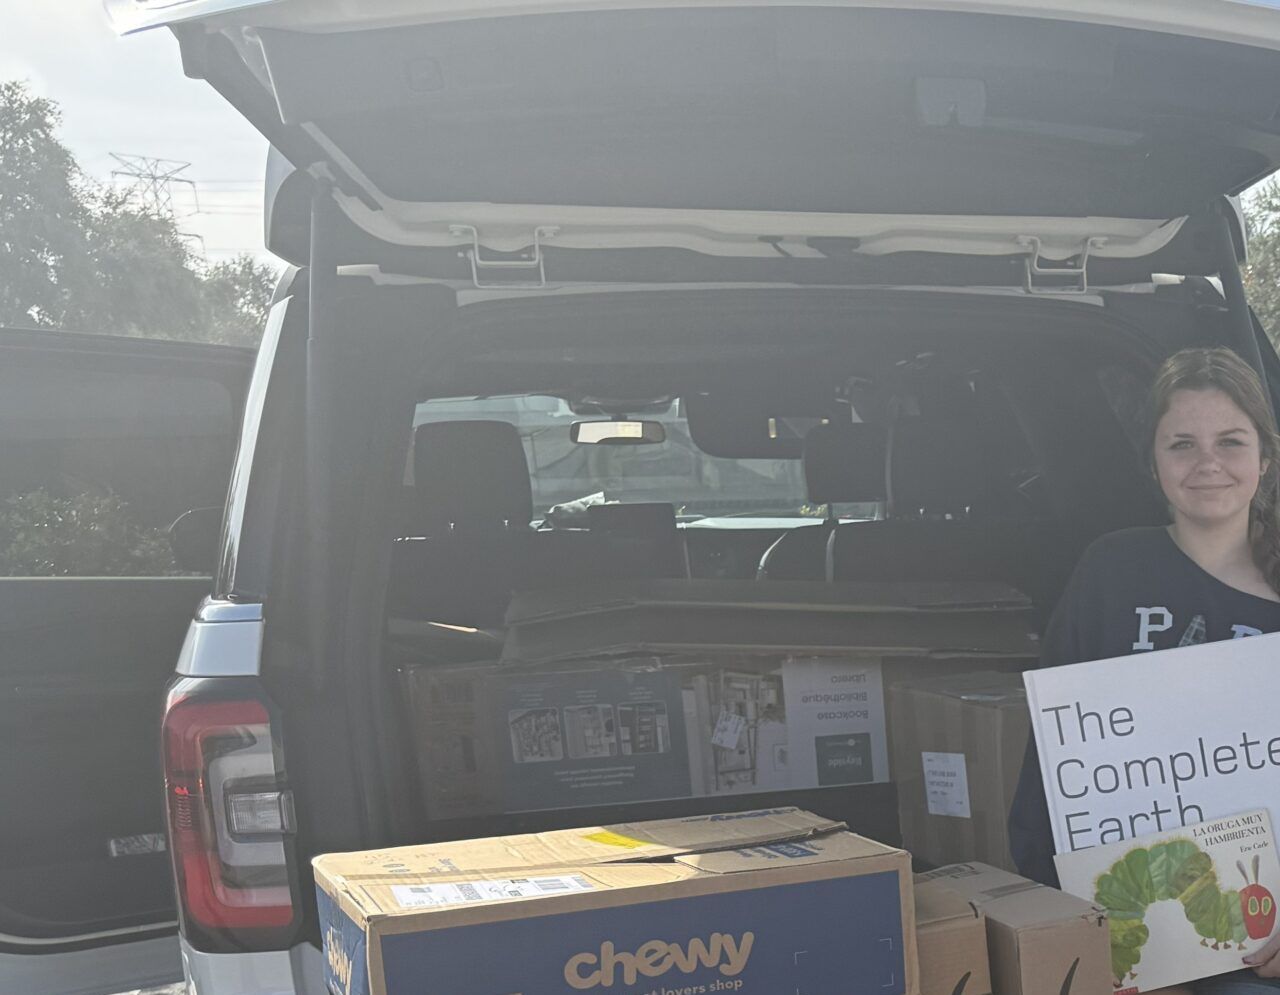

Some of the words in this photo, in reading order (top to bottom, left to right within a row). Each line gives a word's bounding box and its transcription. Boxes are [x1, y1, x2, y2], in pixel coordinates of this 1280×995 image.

[1042, 702, 1135, 746] The
[1065, 794, 1204, 852] Earth
[1193, 826, 1206, 837] LA
[1207, 818, 1241, 833] ORUGA
[1241, 813, 1264, 826] MUY
[1204, 826, 1266, 847] HAMBRIENTA
[564, 931, 755, 990] chewy
[709, 978, 743, 993] shop
